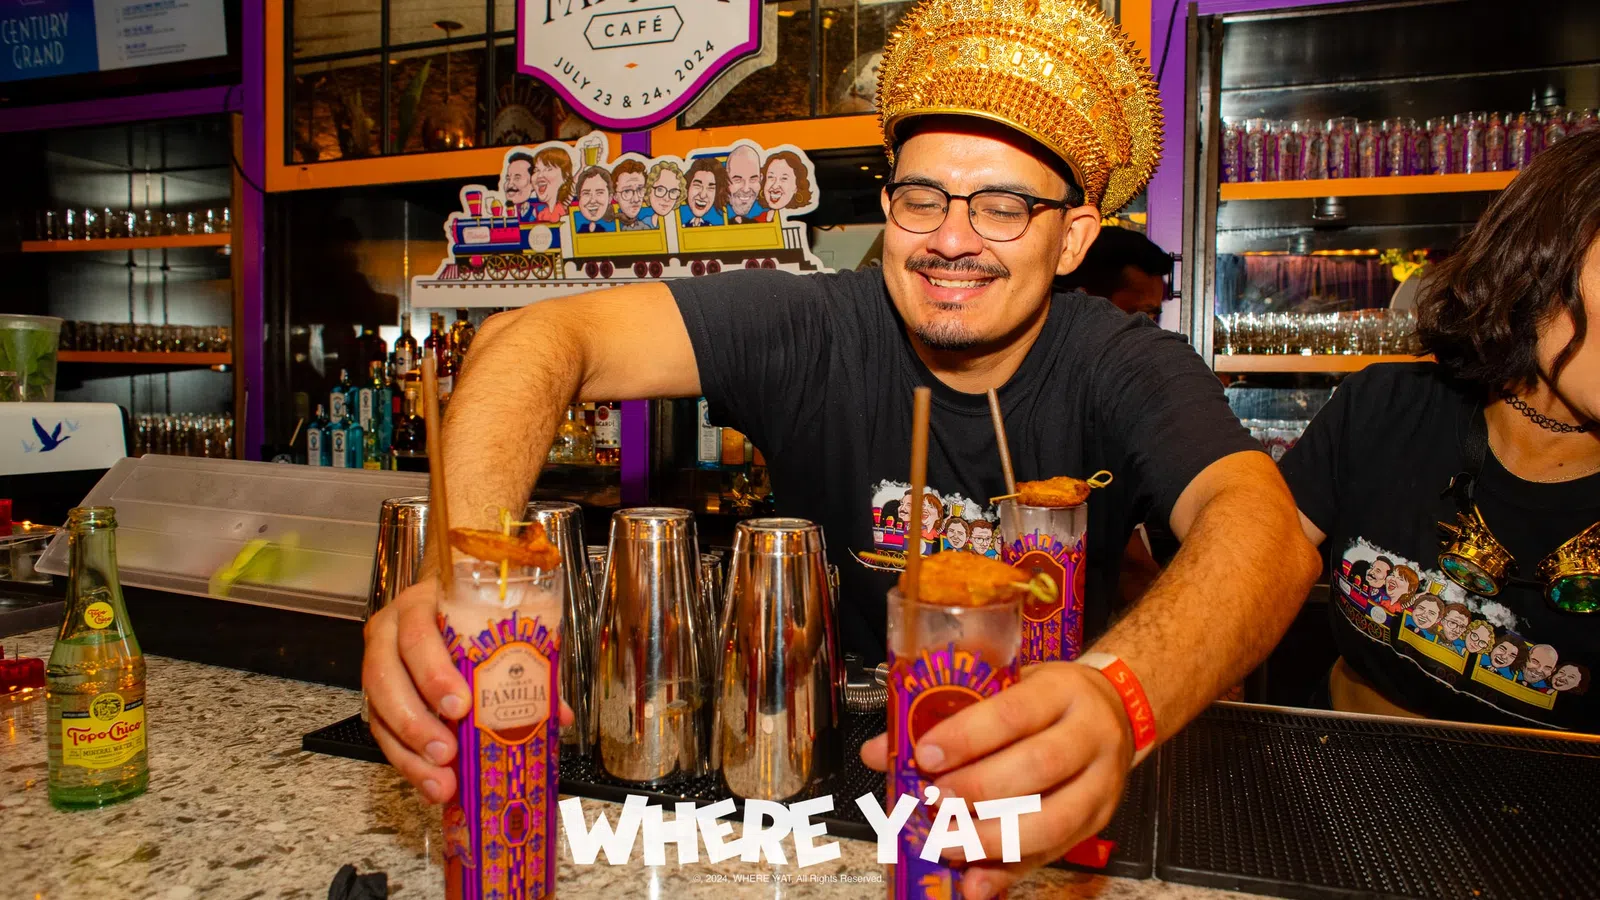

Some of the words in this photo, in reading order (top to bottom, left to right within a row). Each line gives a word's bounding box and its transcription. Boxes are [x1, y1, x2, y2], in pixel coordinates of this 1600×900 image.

[1, 12, 69, 44] CENTURY
[604, 15, 662, 37] CAFÉ
[12, 40, 65, 69] GRAND
[554, 57, 590, 90] JULY
[593, 89, 612, 106] 23
[622, 95, 632, 108] &
[642, 87, 671, 105] 24,
[675, 40, 714, 81] 2024
[88, 609, 107, 618] Topo
[95, 616, 112, 624] Chico
[481, 685, 547, 709] FAMILIA
[67, 727, 107, 746] Topo
[108, 720, 142, 741] Chico
[83, 748, 112, 757] MINERAL
